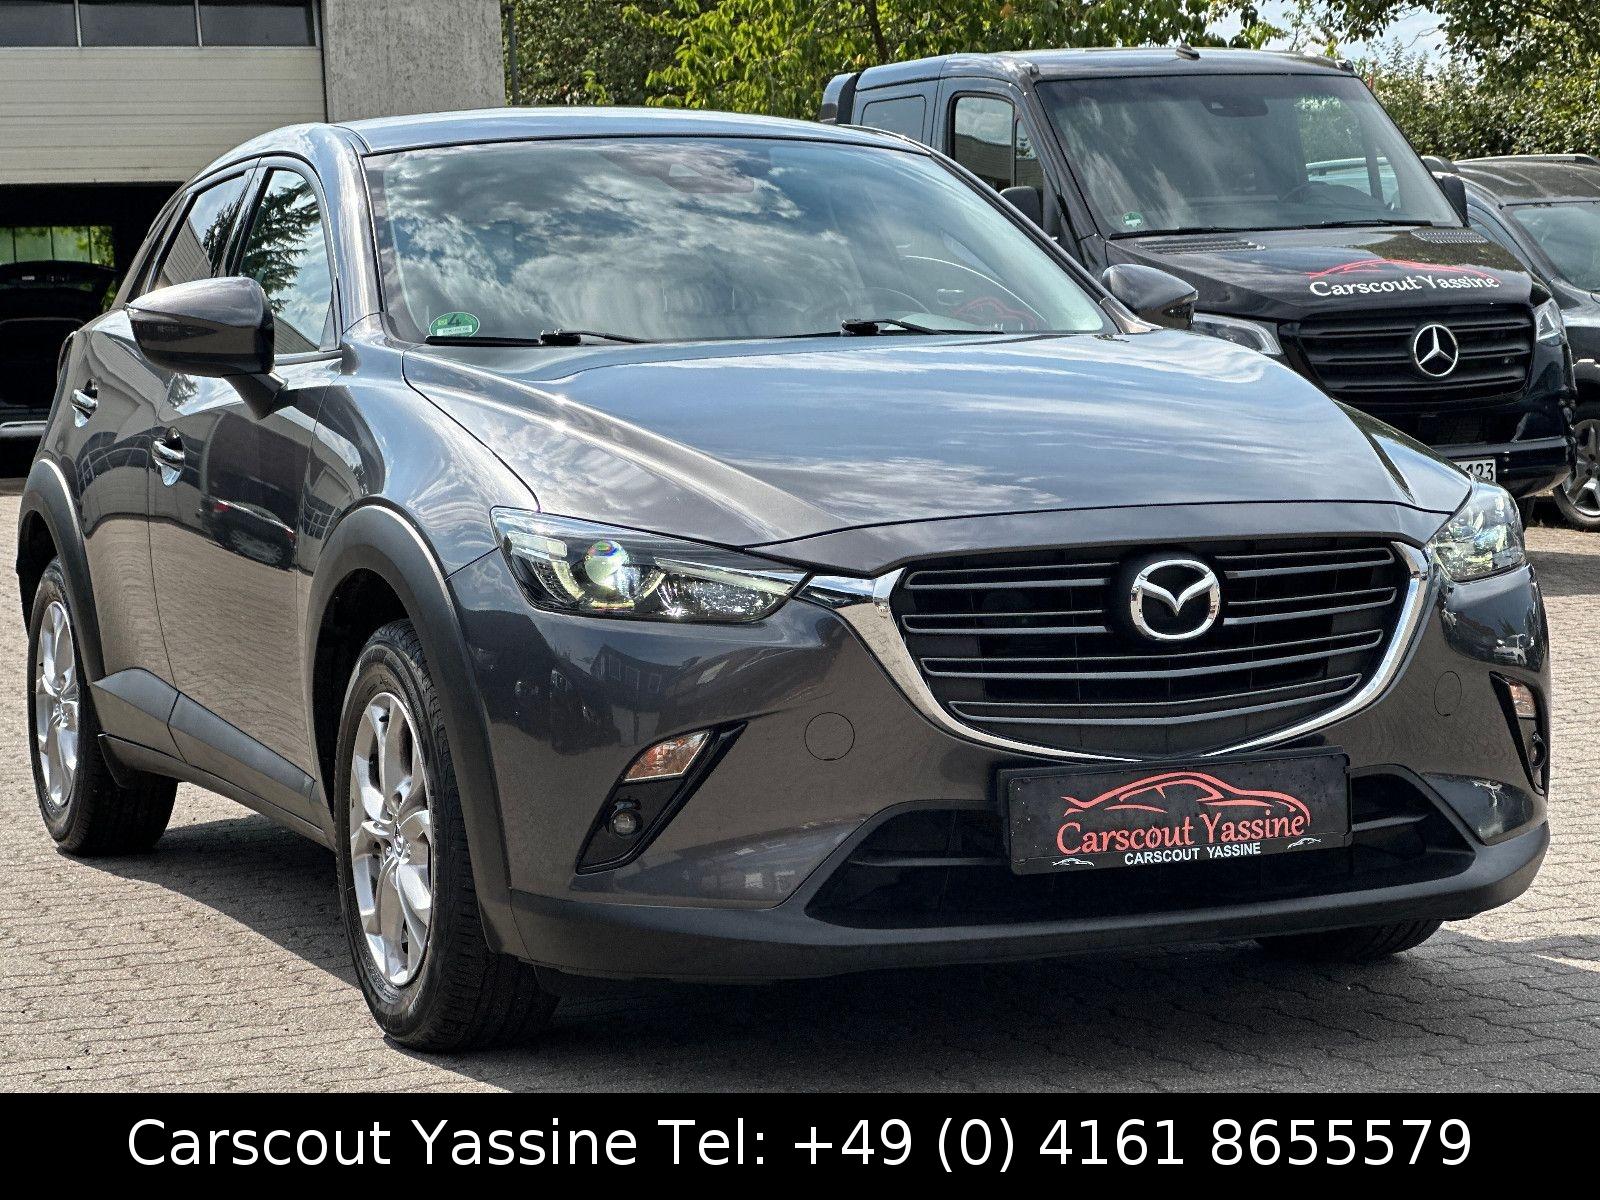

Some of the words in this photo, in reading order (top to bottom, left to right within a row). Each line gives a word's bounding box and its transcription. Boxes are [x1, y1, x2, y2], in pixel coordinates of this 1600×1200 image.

[1309, 275, 1422, 297] Carscout
[1418, 275, 1500, 290] Yassine
[447, 313, 462, 327] 4
[1056, 817, 1196, 855] Carscout
[1199, 809, 1305, 844] Yassine
[1124, 847, 1201, 866] CARSCOUT
[1206, 842, 1262, 859] YASSINE
